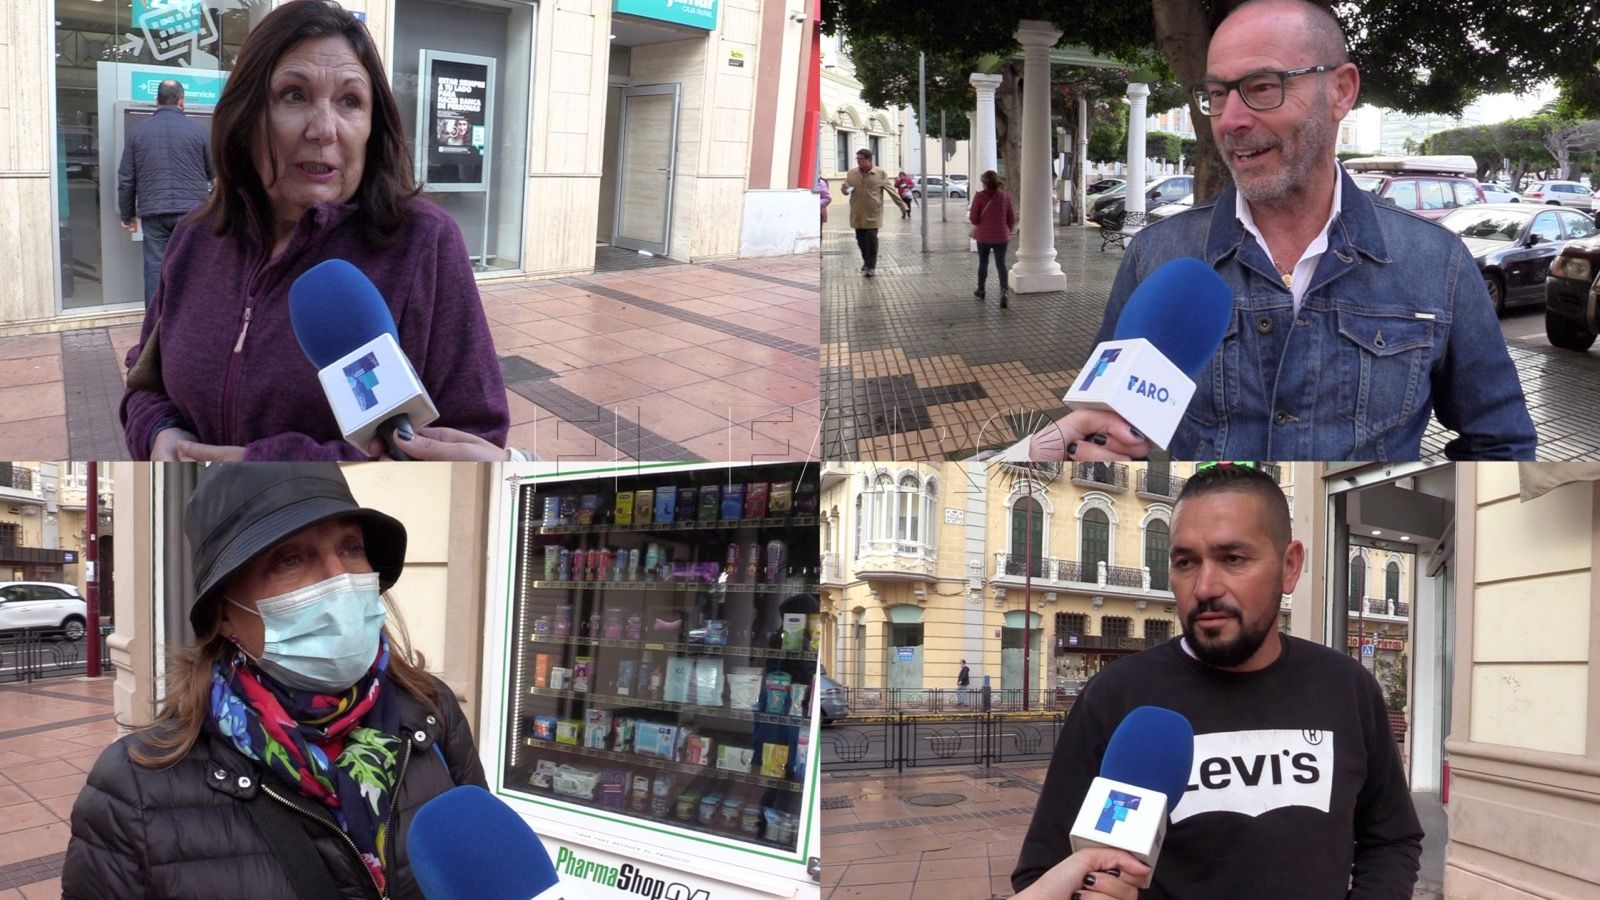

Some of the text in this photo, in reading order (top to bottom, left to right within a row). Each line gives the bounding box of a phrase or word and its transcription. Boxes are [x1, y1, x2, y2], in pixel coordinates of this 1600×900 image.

[1127, 375, 1169, 403] FARO
[1185, 749, 1320, 792] evi's
[556, 846, 665, 900] PharmaShop
